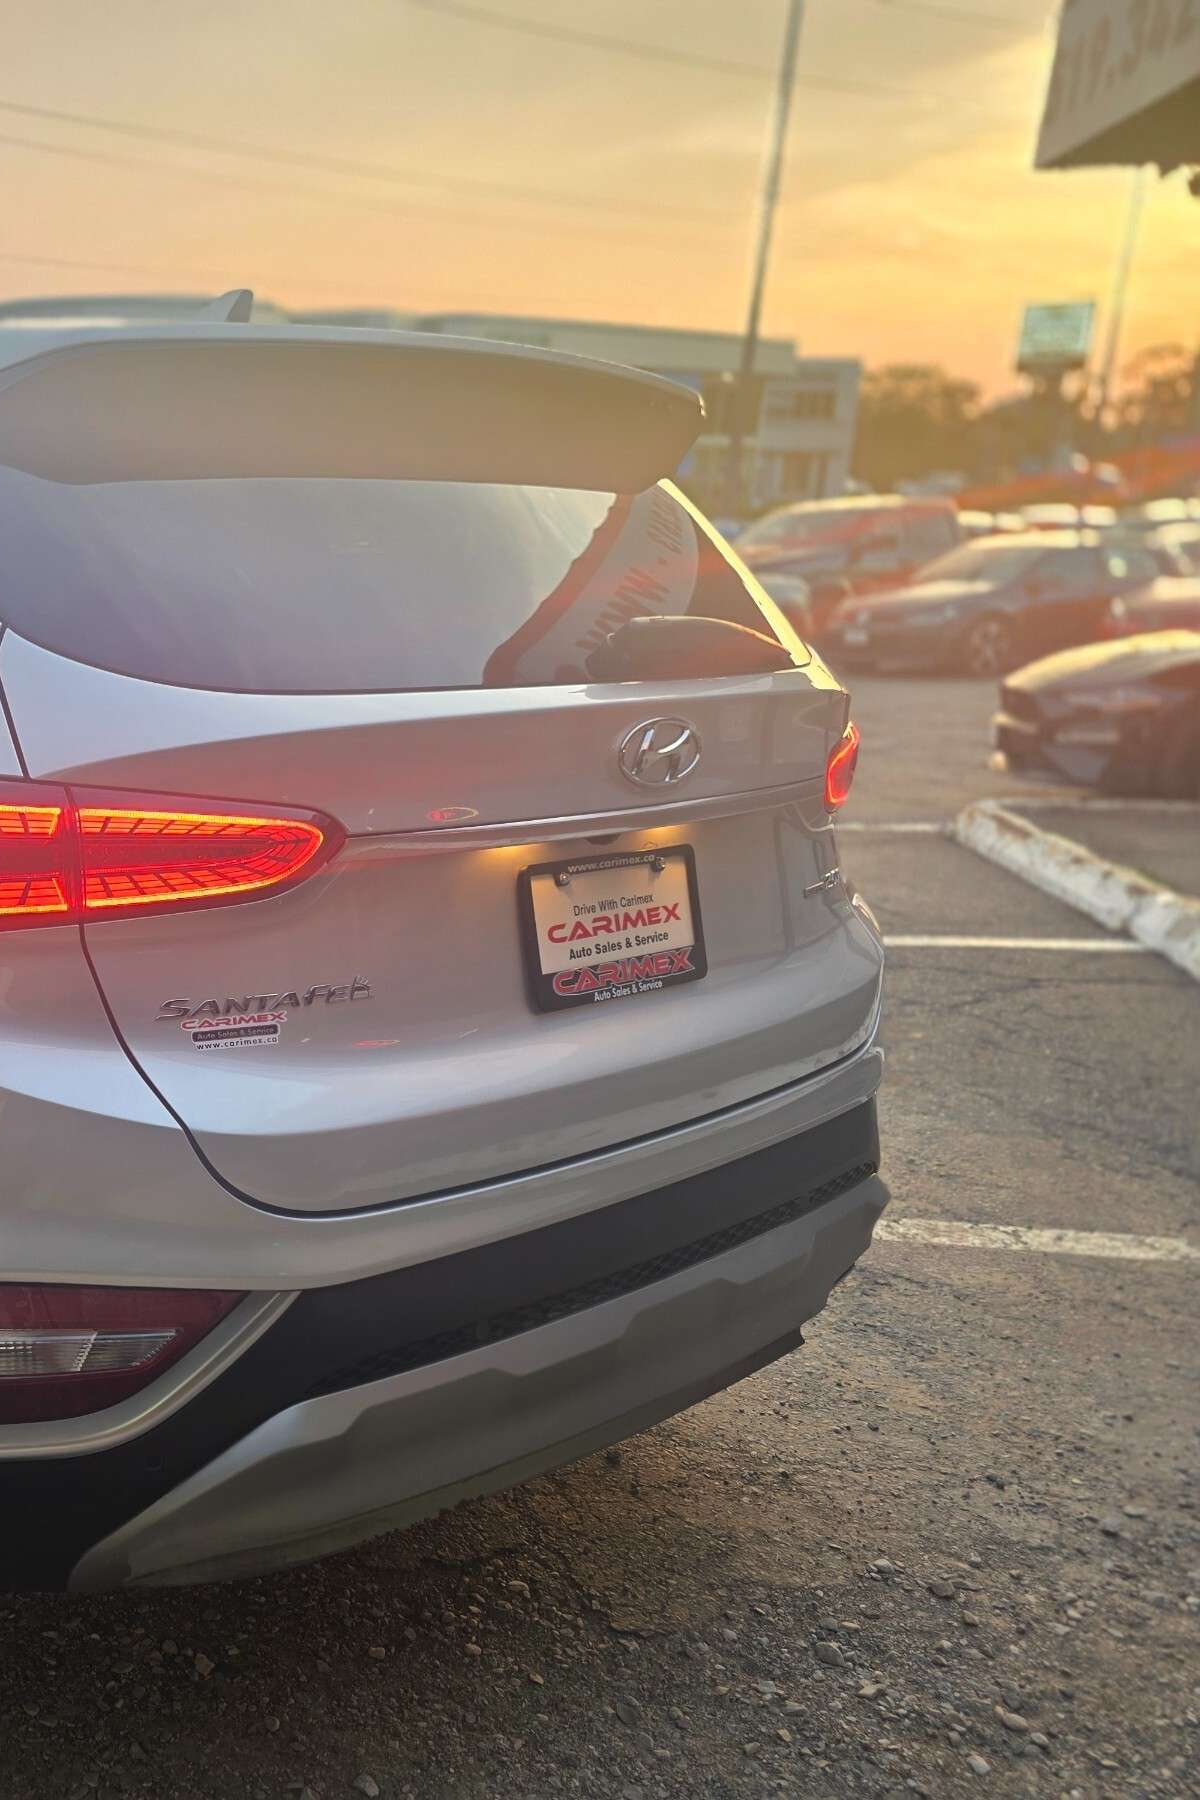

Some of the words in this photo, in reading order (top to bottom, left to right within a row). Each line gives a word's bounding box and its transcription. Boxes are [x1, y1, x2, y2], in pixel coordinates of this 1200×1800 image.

[573, 903, 596, 917] Drive
[598, 898, 618, 913] With
[620, 893, 654, 908] Carimex
[547, 902, 682, 944] CARIMEX
[569, 945, 593, 960] Auto
[595, 940, 623, 956] Sales
[625, 937, 633, 949] &
[635, 931, 669, 947] Service
[554, 949, 693, 994] CARIMEX
[594, 987, 611, 1002] Auto
[612, 983, 631, 998] Sales
[632, 981, 639, 993] &
[639, 979, 663, 993] Service
[181, 1012, 285, 1030] CARIMEX
